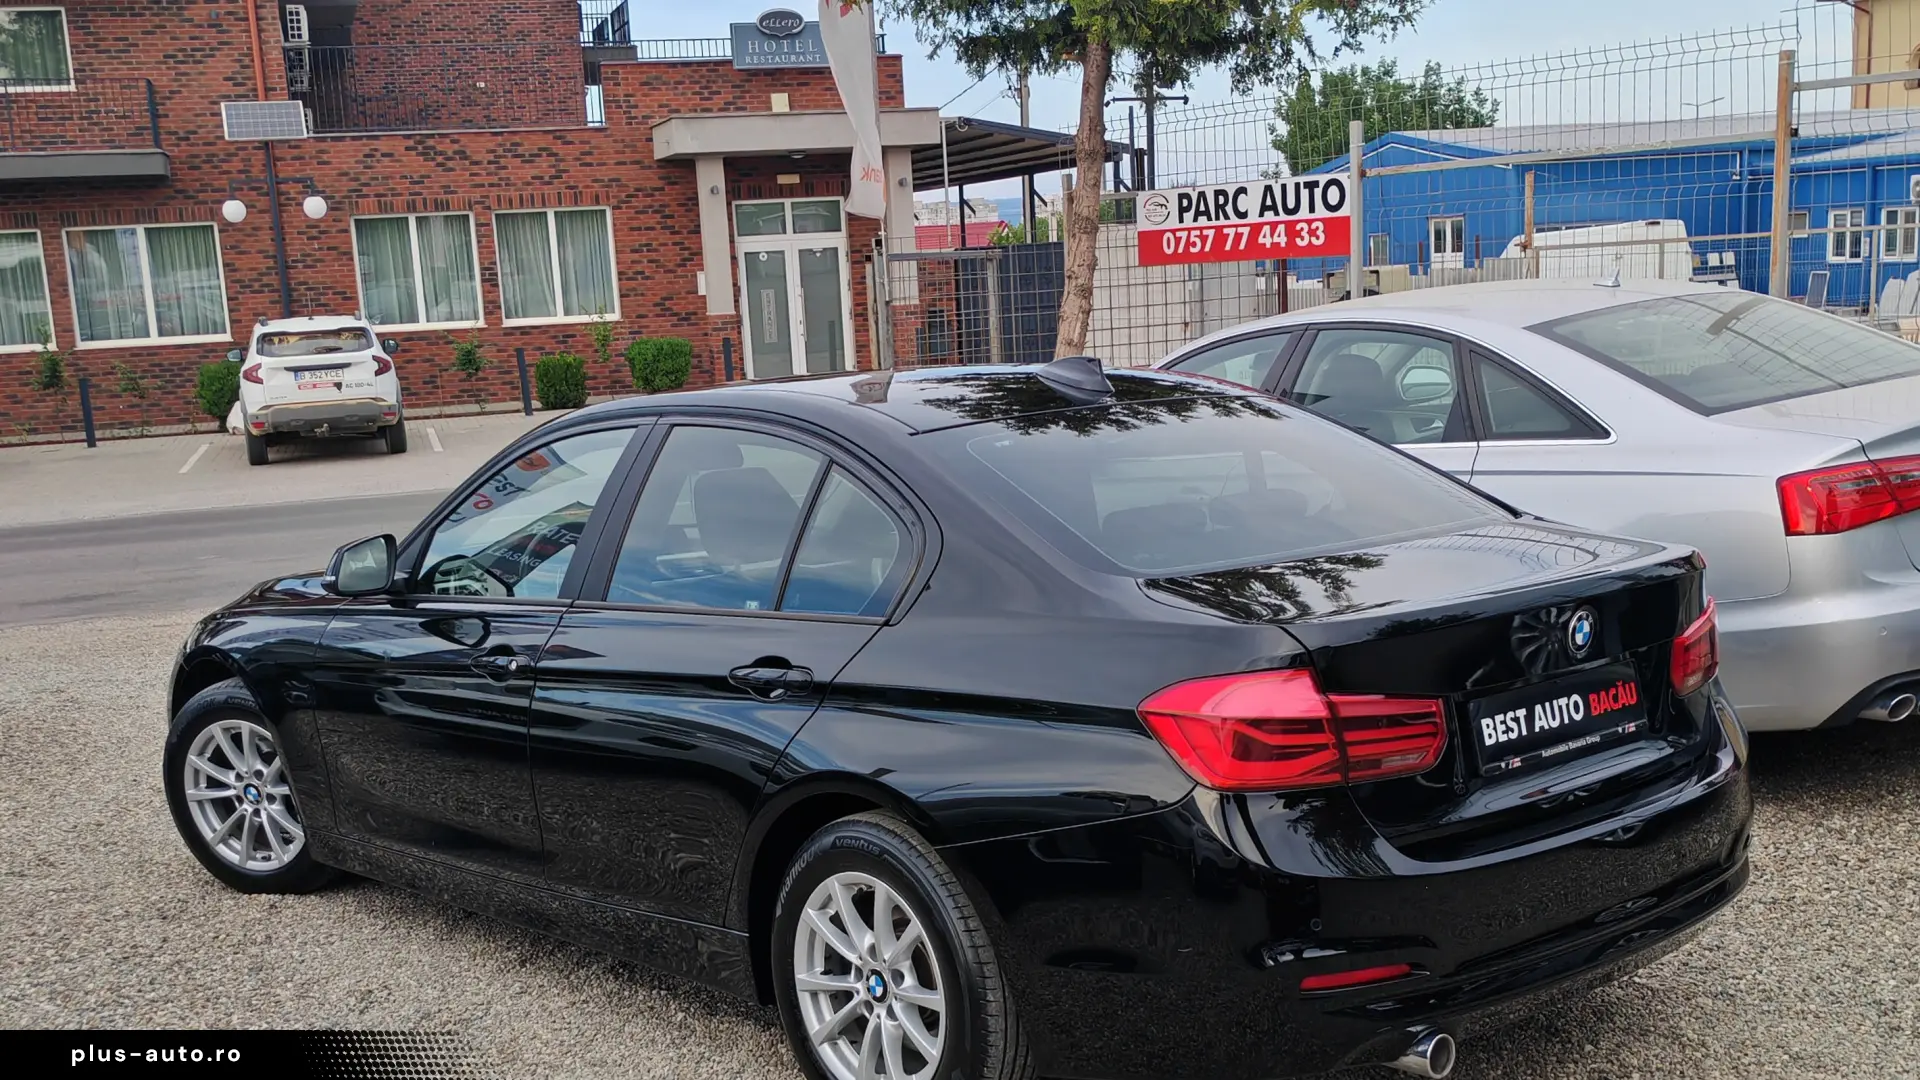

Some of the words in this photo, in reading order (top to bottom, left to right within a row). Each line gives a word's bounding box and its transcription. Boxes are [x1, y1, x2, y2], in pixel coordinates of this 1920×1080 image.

[745, 54, 821, 64] RESTAURANT
[748, 40, 818, 53] HOTEL
[1177, 186, 1249, 224] PARC
[1258, 177, 1346, 218] AUTO
[1162, 228, 1215, 255] 0757
[1223, 226, 1250, 251] 77
[1258, 223, 1287, 249] 44
[1295, 220, 1326, 247] 33
[487, 545, 541, 567] LEASING
[1480, 708, 1528, 746] BEST
[1534, 693, 1585, 732] AUTO
[1588, 679, 1638, 716] BACĂU
